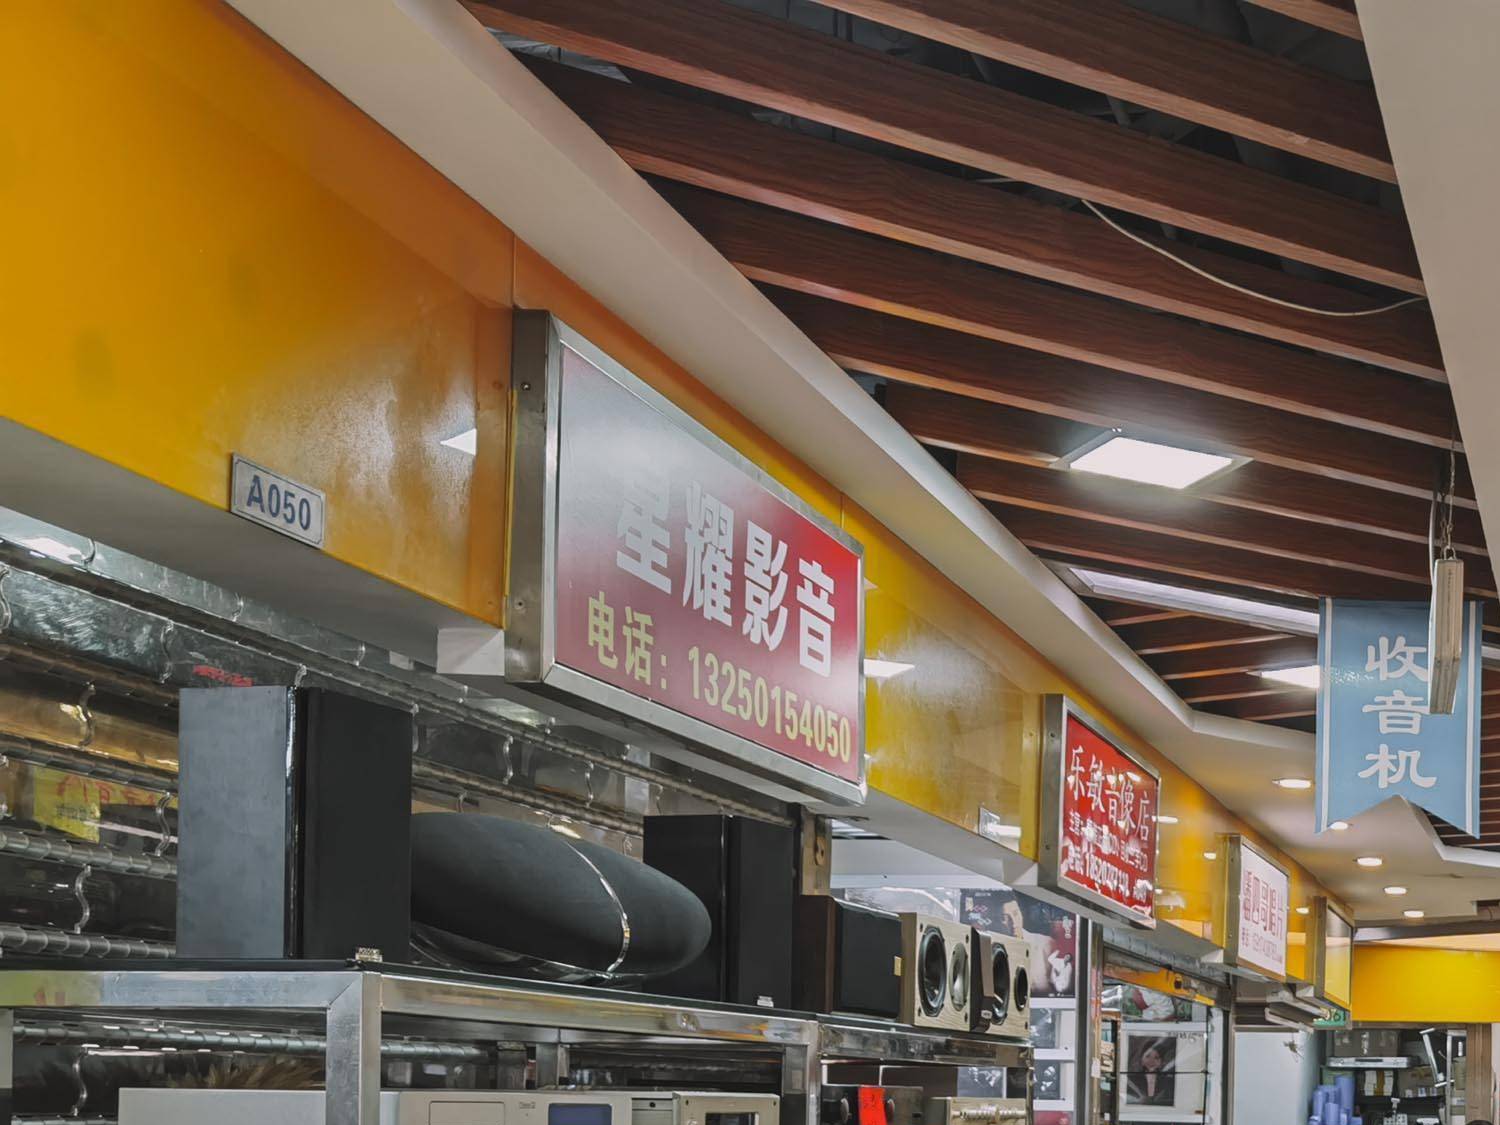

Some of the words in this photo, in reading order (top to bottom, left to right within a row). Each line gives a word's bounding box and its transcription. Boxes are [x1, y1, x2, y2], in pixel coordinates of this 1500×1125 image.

[247, 473, 312, 532] A050
[614, 476, 836, 679] 星耀影音
[587, 590, 853, 765] 电话：13250154050
[1358, 635, 1437, 789] 收音机
